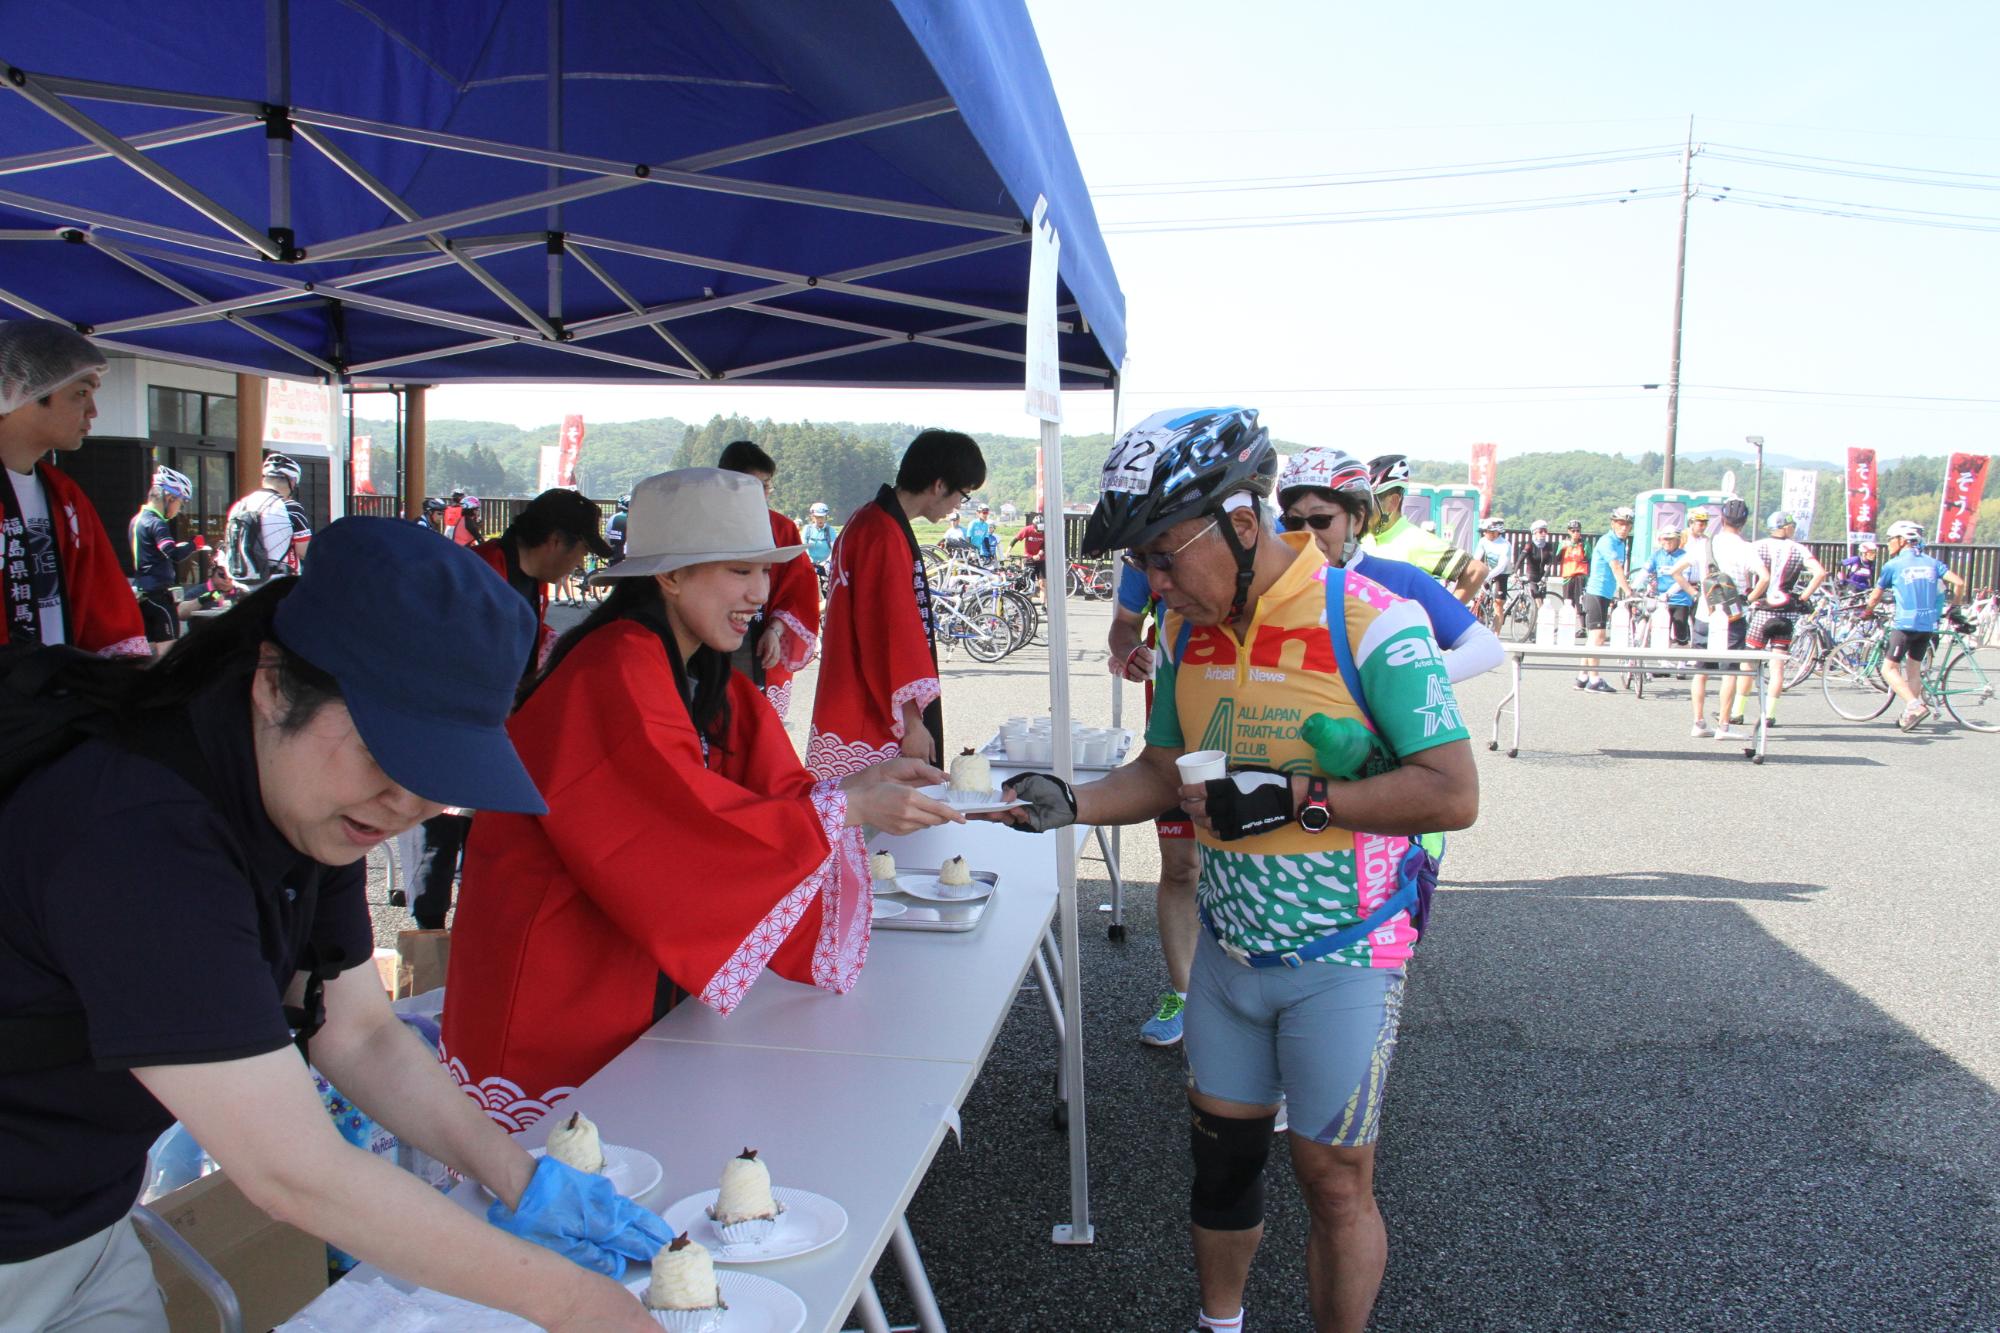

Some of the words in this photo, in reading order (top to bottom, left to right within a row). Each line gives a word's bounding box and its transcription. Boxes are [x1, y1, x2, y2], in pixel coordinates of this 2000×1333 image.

[1856, 463, 1871, 522] そうま
[1949, 471, 1974, 540] そうま
[1181, 624, 1339, 674] an
[1204, 667, 1235, 681] Arbeit
[1249, 670, 1286, 682] News
[1237, 706, 1259, 721] ALL
[1260, 705, 1302, 722] JAPAN
[1235, 742, 1268, 756] CLUB
